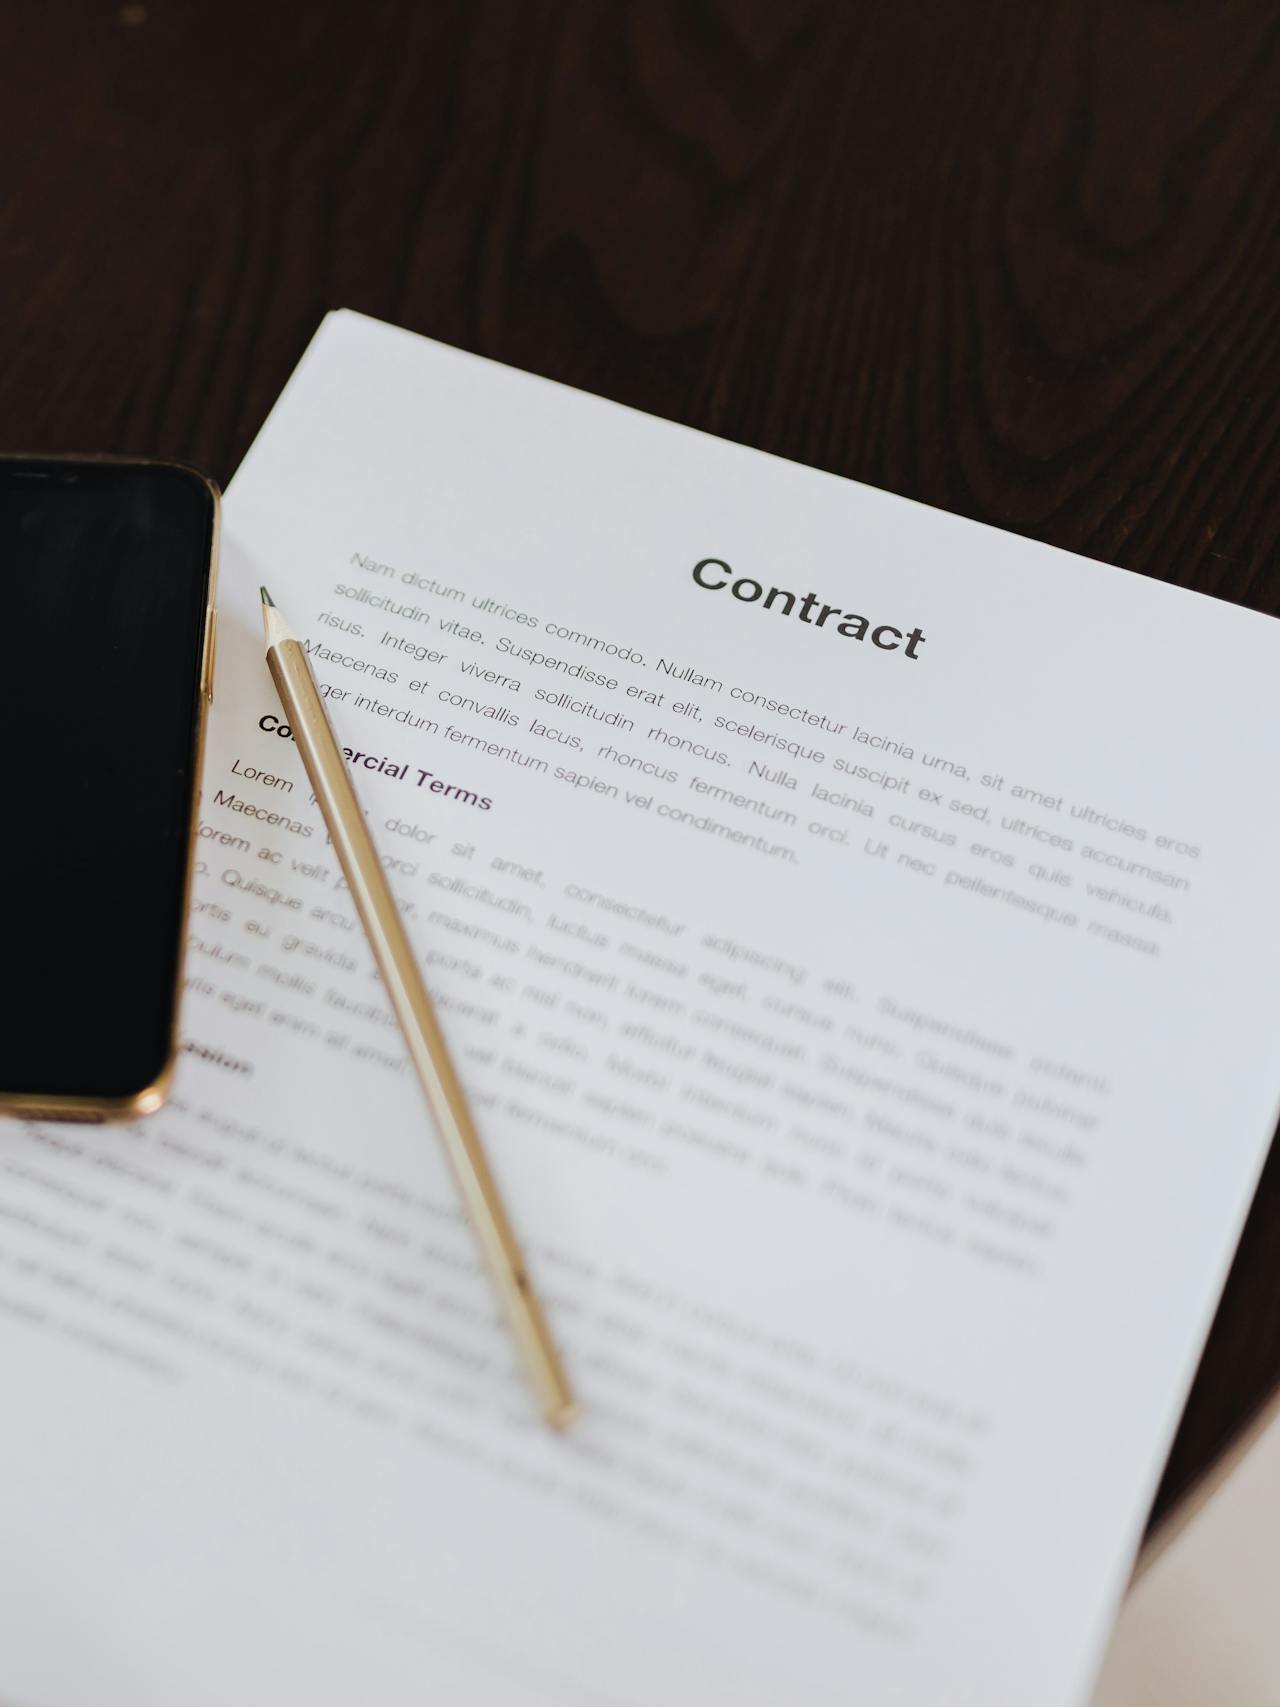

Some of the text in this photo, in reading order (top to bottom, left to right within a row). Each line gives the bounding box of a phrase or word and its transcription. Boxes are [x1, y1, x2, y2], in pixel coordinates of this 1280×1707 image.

[691, 557, 928, 661] Contract
[258, 714, 410, 781] Coercial
[417, 769, 492, 811] Terms
[303, 638, 401, 685] Maecenas
[408, 680, 430, 695] et
[437, 690, 519, 727] convallis
[528, 719, 584, 753] lacus,
[597, 746, 678, 783] rhoncus
[689, 776, 797, 825] fermentum
[807, 822, 849, 846] orci.
[317, 612, 365, 638] risus.
[380, 632, 448, 664] Integer
[460, 662, 521, 692] viverra
[534, 689, 634, 731] sollicitudin
[647, 728, 731, 767] rhoncus.
[747, 761, 798, 791] Nulla
[810, 783, 874, 818] lacinia
[888, 814, 957, 847] cursus
[969, 843, 1015, 868] eros
[334, 584, 430, 624] sollicitudin
[439, 619, 485, 645] vitae.
[495, 637, 618, 690] Suspendisse
[625, 686, 665, 707] erat
[671, 701, 702, 723] elit,
[714, 716, 825, 764] scelerisque
[833, 759, 910, 794] suscipit
[917, 788, 943, 806] ex
[949, 799, 990, 825] sed,
[1000, 818, 1073, 852] ultrices
[350, 552, 1201, 859] Nam dictum ultrices commodo. Nullam consectetur lacinia urna, sit amet ultricies eros
[213, 789, 311, 836] Maecenas
[231, 759, 294, 793] Lorem
[353, 696, 801, 864] interdum fermentum sapien vel condimentum.
[257, 847, 283, 864] ac
